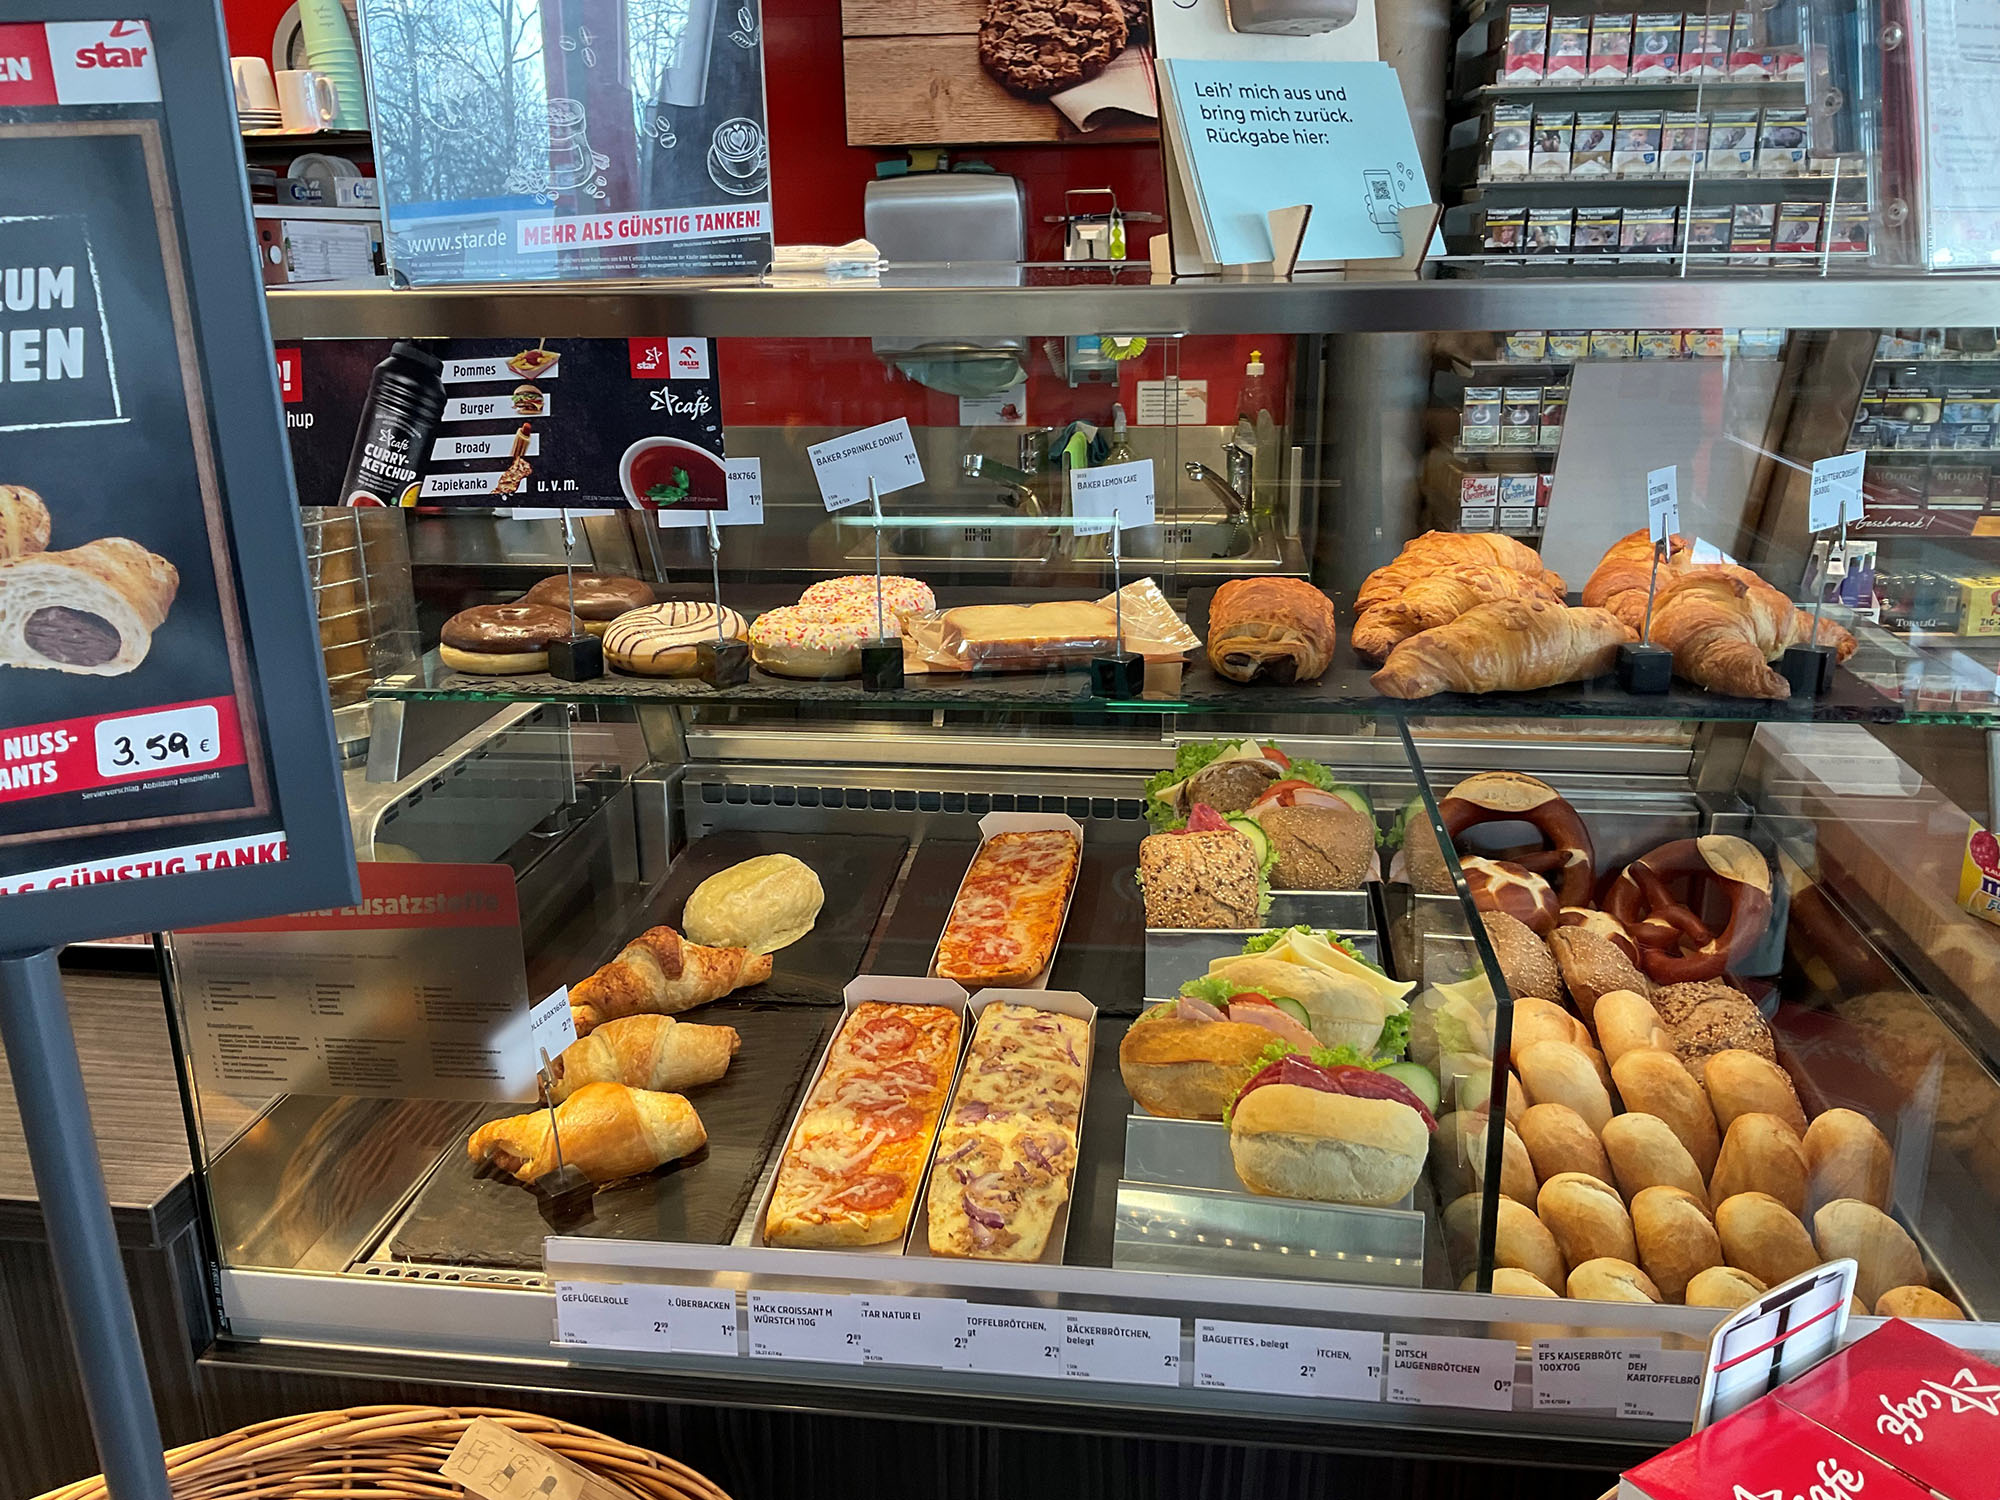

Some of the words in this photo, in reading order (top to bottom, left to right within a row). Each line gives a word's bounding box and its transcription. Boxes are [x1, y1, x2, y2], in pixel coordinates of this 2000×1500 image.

[76, 41, 148, 68] star
[1239, 83, 1280, 100] mich
[1283, 87, 1312, 100] aus
[1315, 86, 1347, 101] und
[1200, 104, 1245, 124] bring
[1250, 105, 1291, 122] mich
[1294, 107, 1353, 123] zurück.
[1206, 127, 1290, 147] Rückgabe
[1293, 129, 1330, 145] hier:
[523, 223, 578, 247] MEHR
[580, 218, 615, 241] ALS
[617, 211, 690, 239] GÜNSTIG
[695, 209, 762, 232] TANKEN!
[407, 229, 507, 253] www.star.de
[0, 266, 74, 312] UM
[0, 327, 84, 383] EN
[453, 364, 496, 377] Pommes
[636, 361, 657, 370] star
[460, 402, 495, 417] Burger
[674, 395, 713, 421] café
[391, 439, 410, 452] café
[455, 441, 491, 456] Broady
[816, 452, 842, 466] BAKER
[842, 440, 878, 458] SPRINKLE
[878, 432, 904, 447] DONUT
[365, 443, 410, 466] CURRY-
[361, 456, 417, 482] KETCHUP
[728, 472, 756, 481] 48X76G
[1077, 480, 1101, 490] BAKER
[1102, 477, 1122, 487] LEMON
[1123, 474, 1137, 483] CAKE
[1937, 472, 1984, 481] MOODS
[431, 477, 488, 493] Zapiekanka
[537, 480, 549, 492] u.
[551, 481, 562, 492] v.
[564, 479, 579, 491] m.
[4, 730, 78, 761] NUSS-
[113, 732, 190, 766] 3.59
[199, 739, 210, 752] €
[143, 778, 178, 790] Abbildung
[562, 1293, 629, 1305] GEFLÜGELROLLE
[675, 1297, 730, 1310] ÜBERBACKEN
[753, 1305, 776, 1313] HACK
[777, 1306, 824, 1316] CROISSANT
[825, 1309, 832, 1317] M
[882, 1311, 911, 1320] NATUR
[754, 1314, 795, 1326] WÜRSTCH
[797, 1318, 816, 1327] 110G
[1066, 1324, 1151, 1340] BÄCKERBRÖTCHEN,
[1066, 1336, 1095, 1346] belegt
[1261, 1339, 1289, 1349] belegt
[1395, 1349, 1427, 1359] DITSCH
[1539, 1352, 1556, 1361] EFS
[1395, 1360, 1480, 1374] LAUGENBRÖTCHEN
[1539, 1363, 1581, 1372] 100X70G
[1628, 1362, 1647, 1371] DEH
[1876, 1388, 1942, 1445] café
